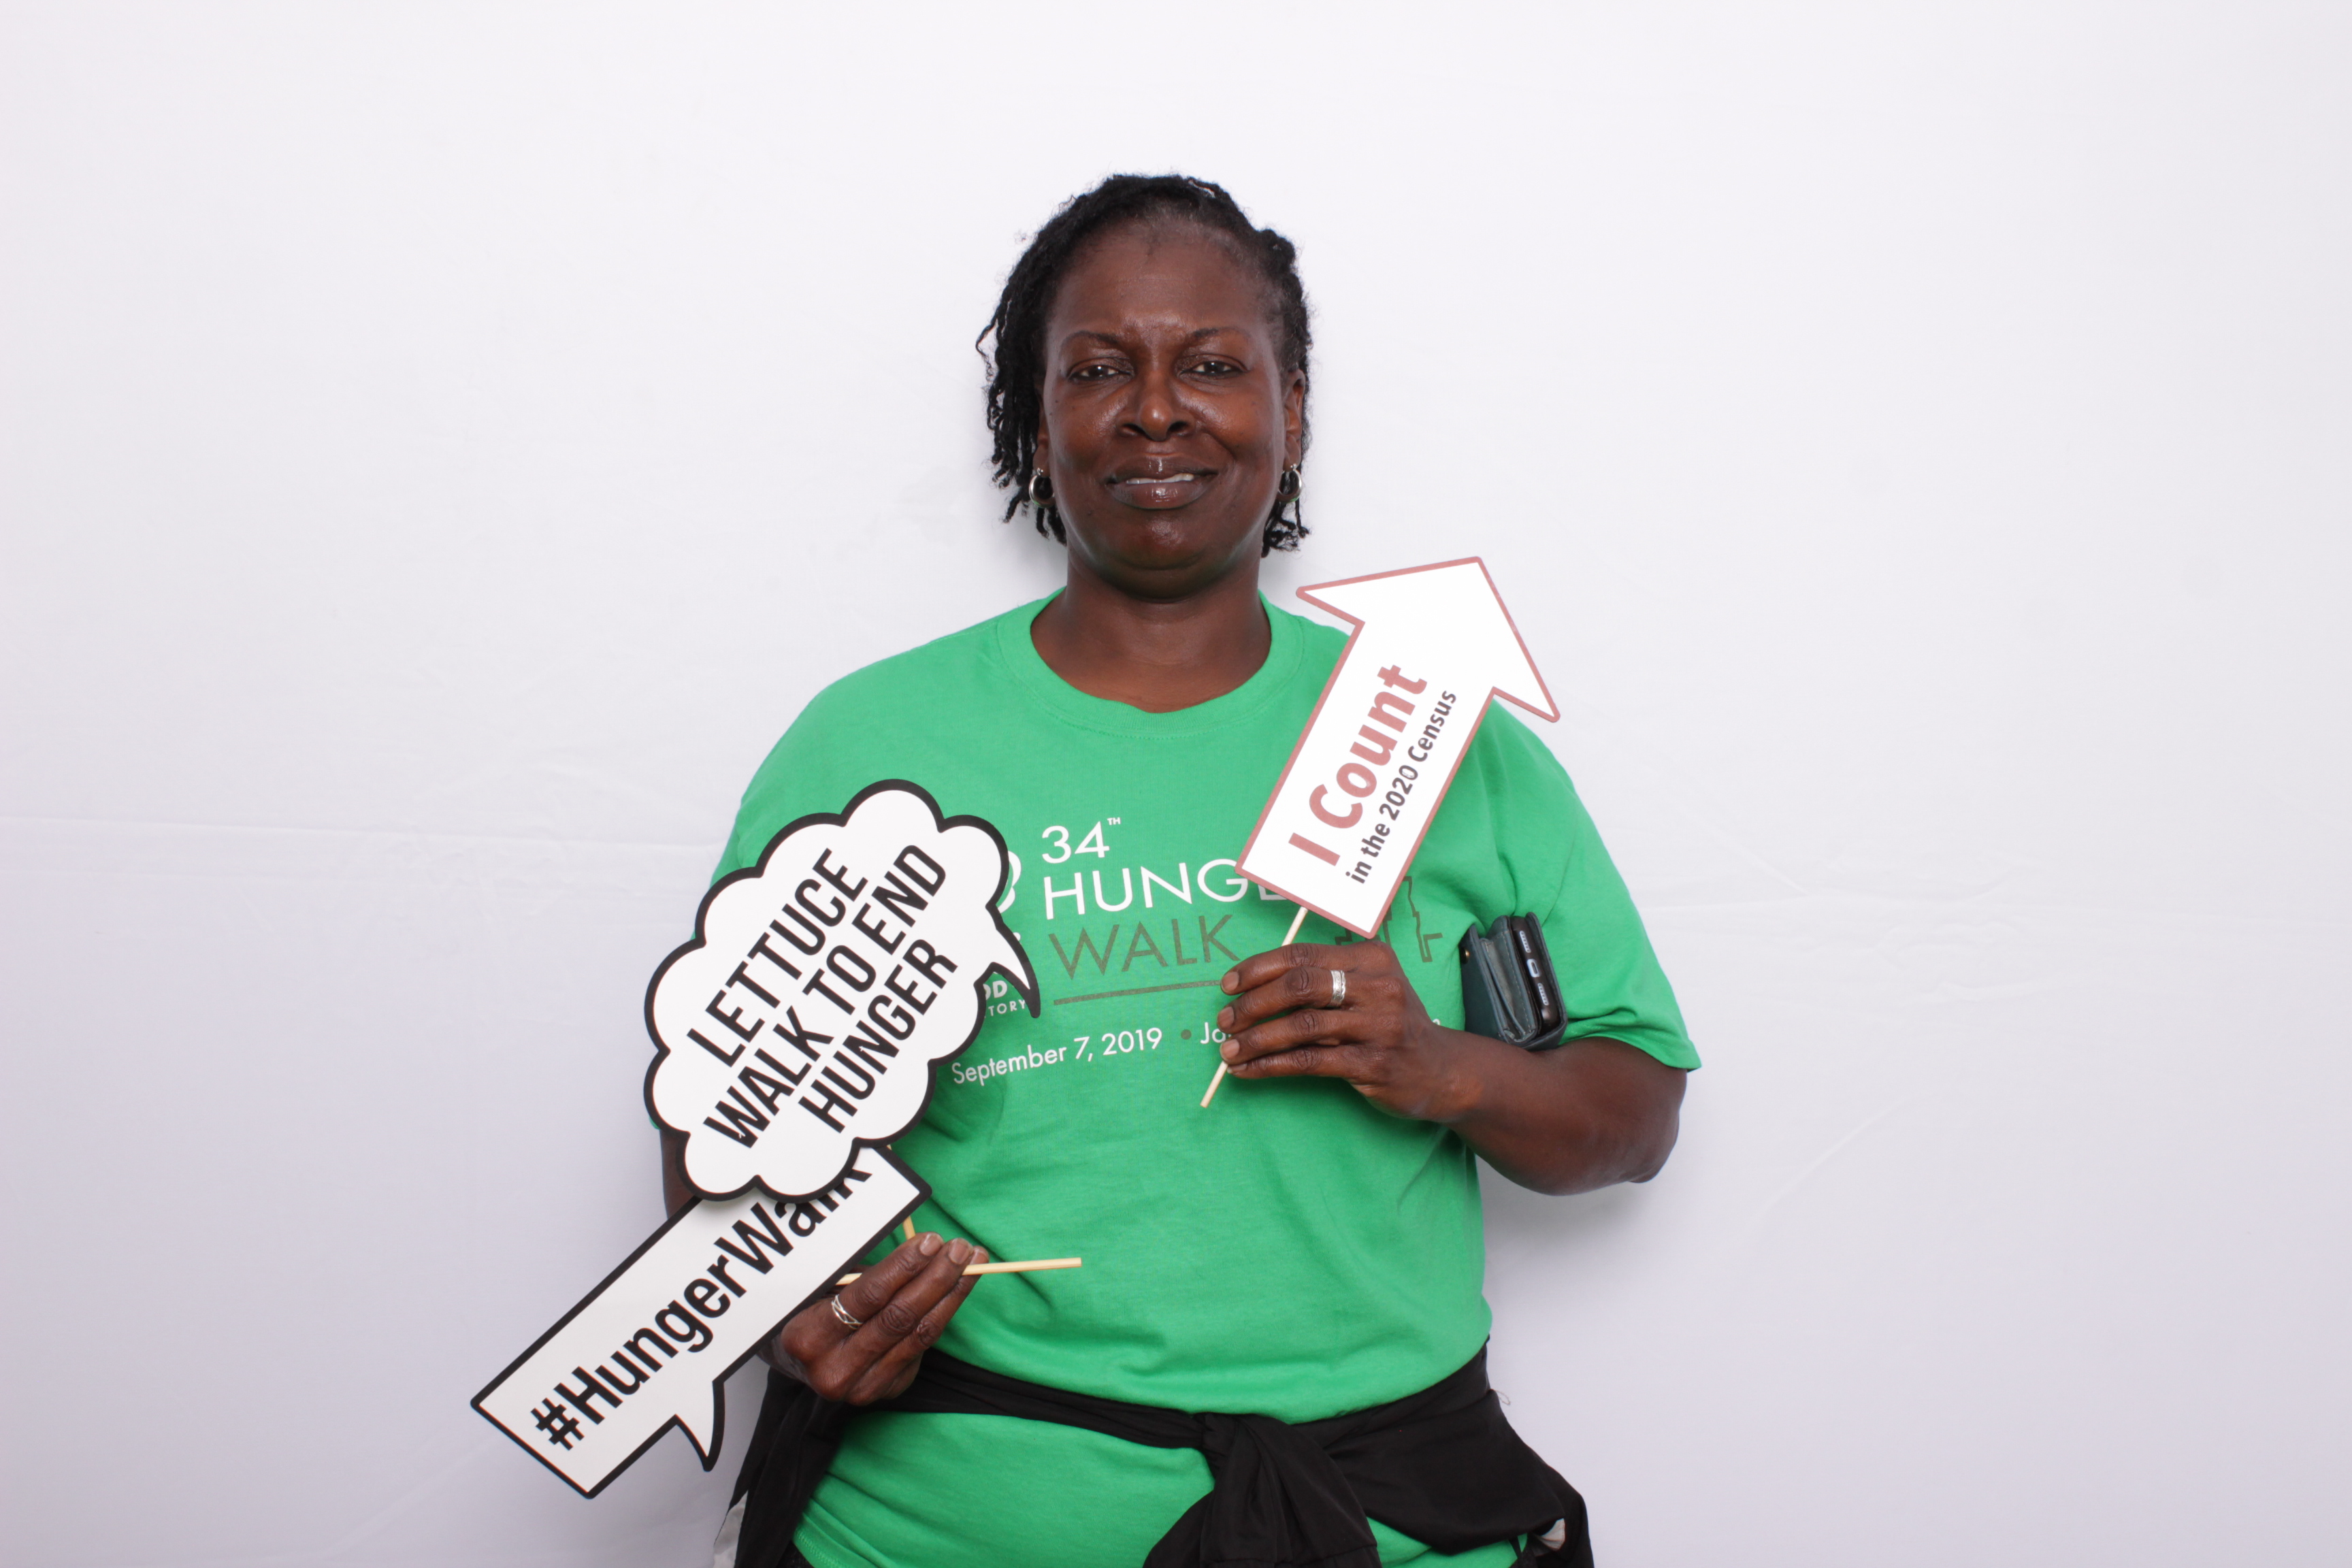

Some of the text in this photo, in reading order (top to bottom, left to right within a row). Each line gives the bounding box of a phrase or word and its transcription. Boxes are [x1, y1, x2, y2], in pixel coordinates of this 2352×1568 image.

[1288, 665, 1427, 866] I Count
[1345, 690, 1456, 884] in the 2020 Census
[687, 848, 868, 1067] LETTUCE
[704, 845, 946, 1148] WALK TO END
[798, 939, 958, 1133] HUNGER
[1048, 913, 1241, 981] WALK
[951, 1044, 1068, 1087] September
[1073, 1036, 1094, 1062] 7,
[1100, 1026, 1163, 1056] 2019
